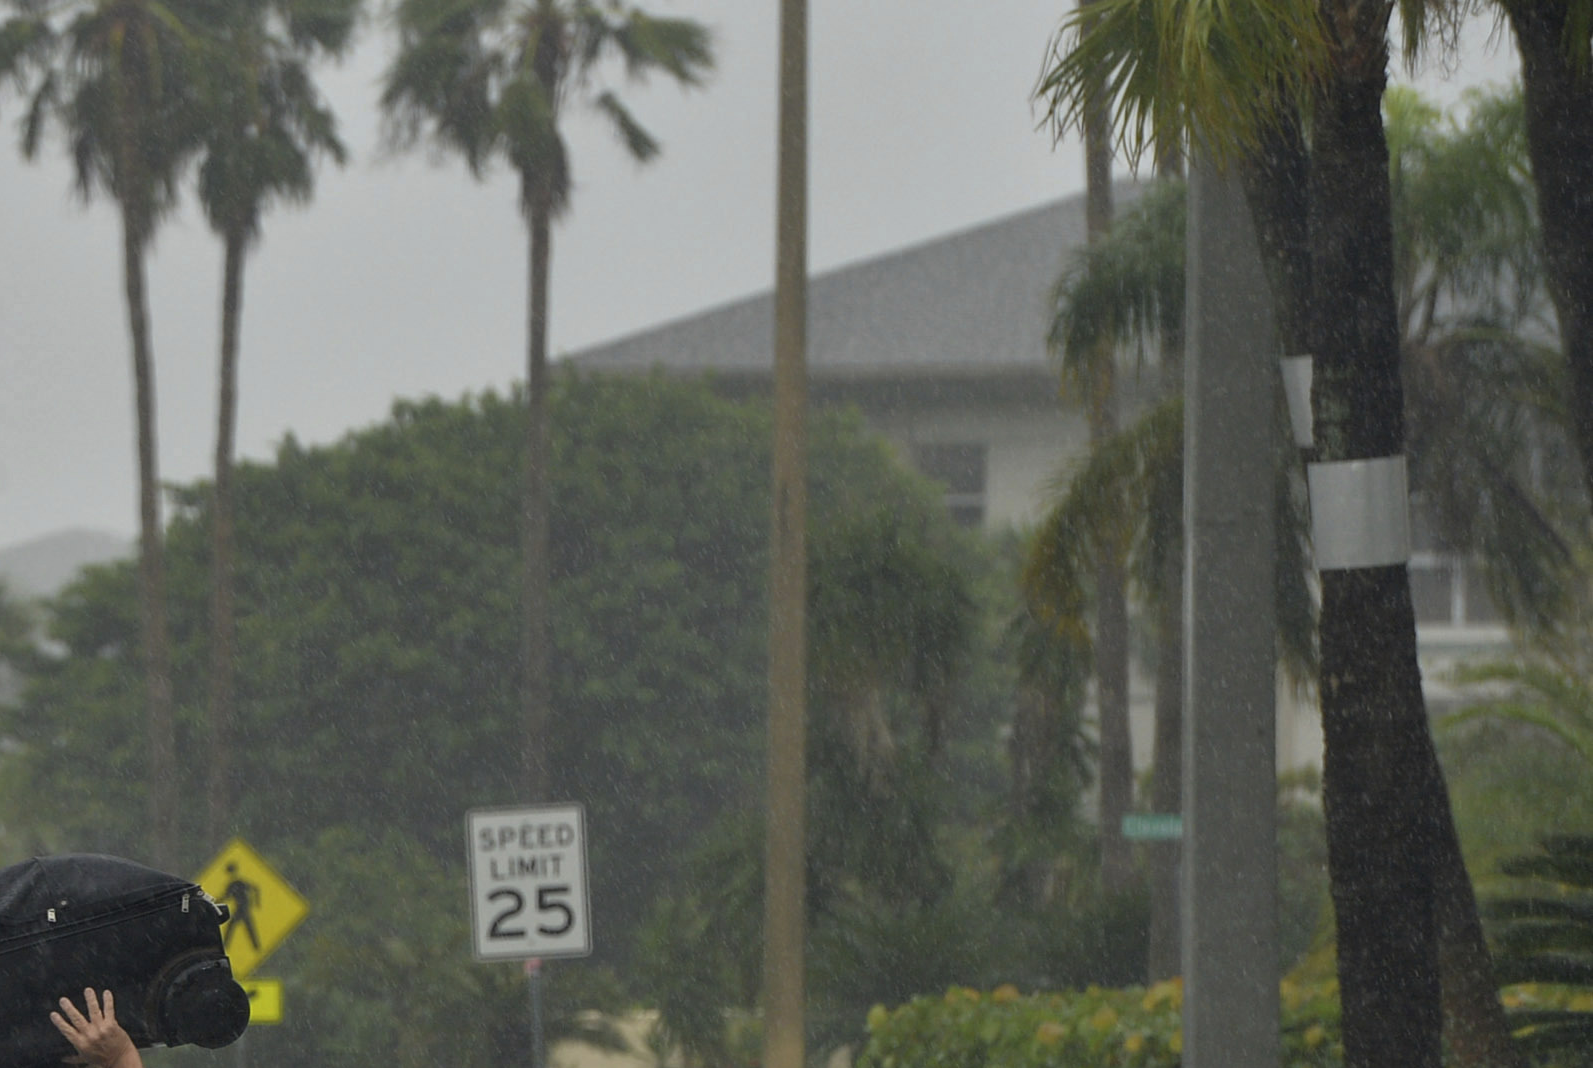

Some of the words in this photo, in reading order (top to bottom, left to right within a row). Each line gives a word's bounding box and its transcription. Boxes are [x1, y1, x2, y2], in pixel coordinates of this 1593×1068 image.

[479, 822, 575, 852] SPEED
[490, 853, 563, 881] LIMIT
[486, 884, 575, 941] 25
